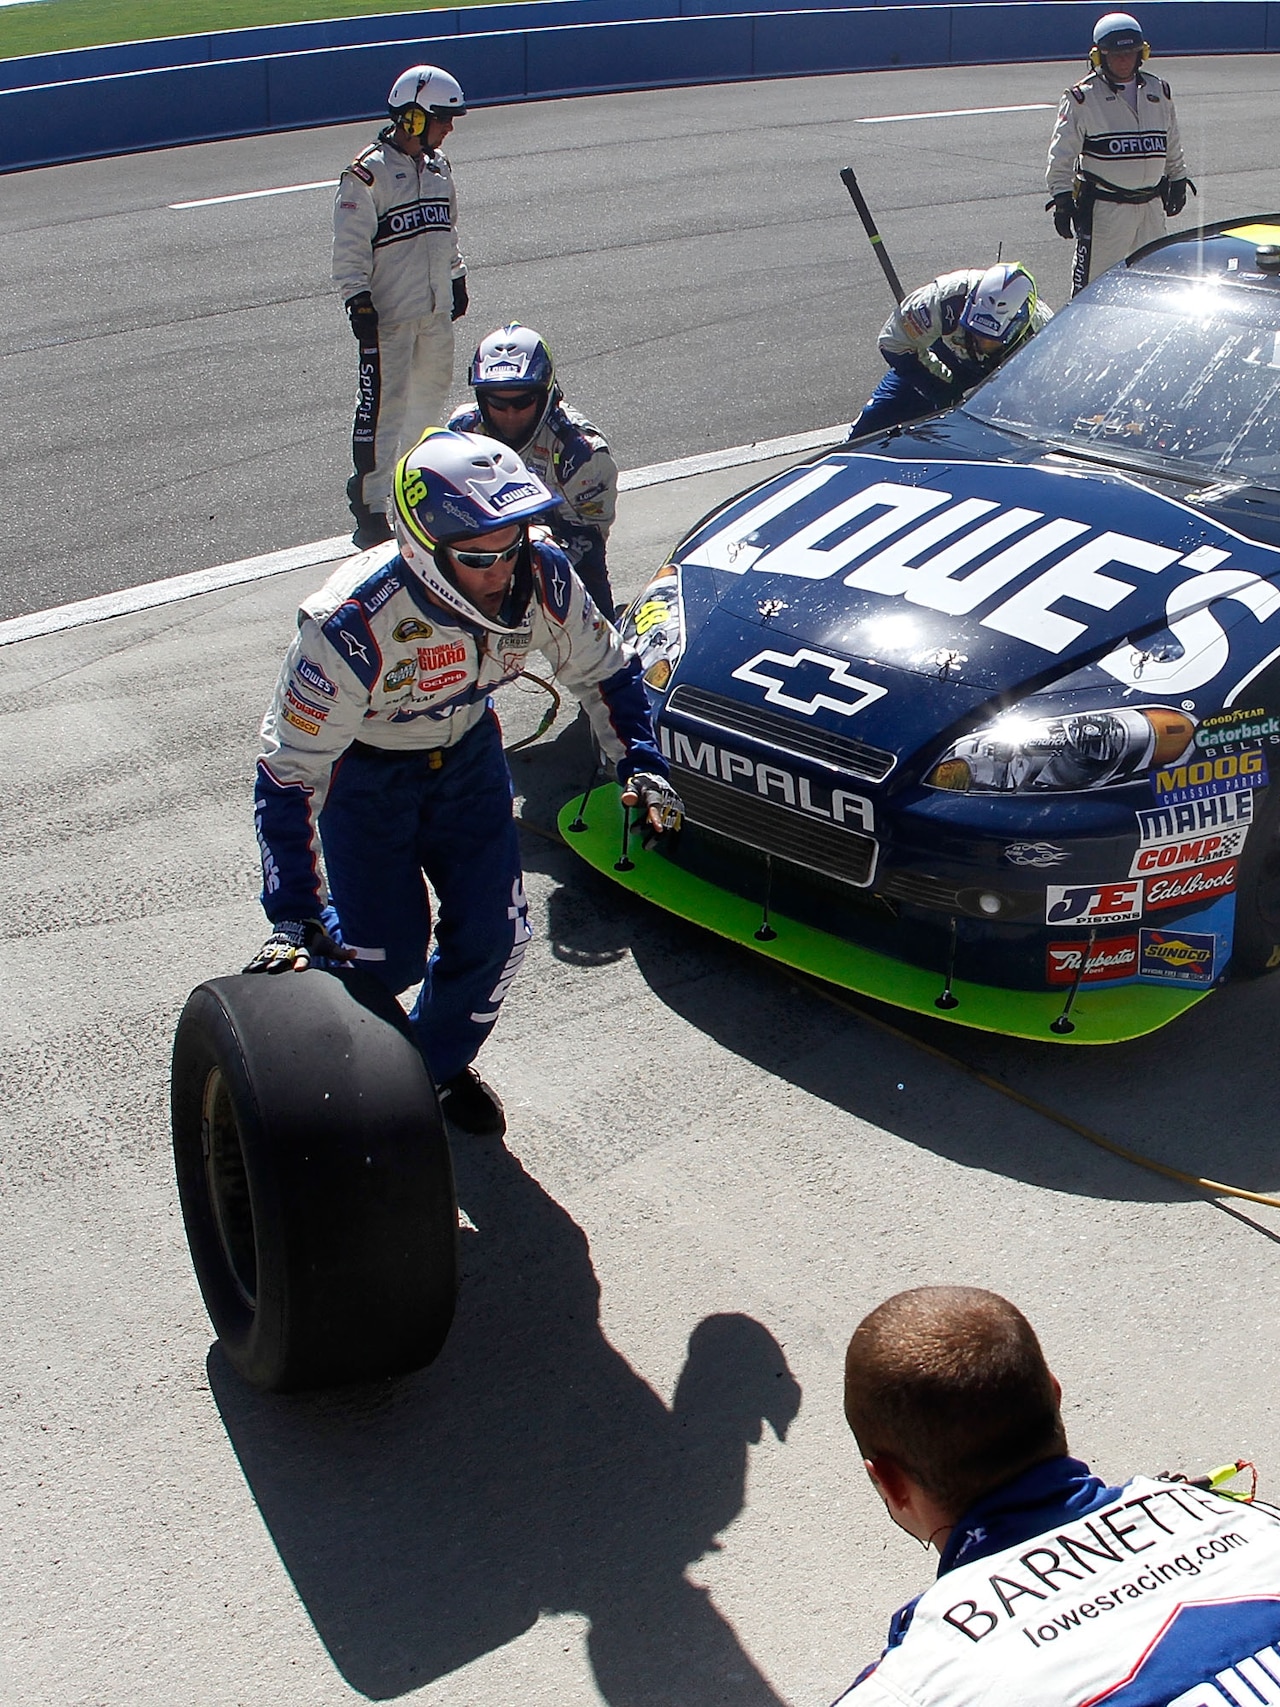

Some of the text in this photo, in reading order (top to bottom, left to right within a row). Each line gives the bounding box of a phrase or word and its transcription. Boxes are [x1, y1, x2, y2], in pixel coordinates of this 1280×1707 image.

[1109, 136, 1166, 154] OFFICIAL
[390, 206, 450, 233] OFFICIAL
[974, 315, 999, 330] LOWE'S
[360, 363, 374, 421] Sprint
[403, 469, 428, 508] 48
[494, 485, 540, 508] LOWE'S
[364, 577, 400, 613] LOWE'S
[634, 601, 671, 636] 48
[299, 661, 332, 693] LOWE'S
[419, 651, 466, 672] GUARD
[422, 673, 463, 688] DELPHI
[289, 711, 317, 735] BOSCH
[1195, 717, 1280, 748] Gatorback
[1206, 735, 1280, 758] BELTS
[661, 724, 875, 833] IMPALA
[1156, 750, 1263, 794] MOOG
[1164, 773, 1263, 806] CHASSIS PARTS
[1137, 792, 1252, 842] MAHLE
[1137, 836, 1222, 872] COMP
[1147, 865, 1235, 904] Edelbrock
[1047, 882, 1139, 924] JE
[1075, 911, 1141, 924] PISTONS
[1147, 945, 1208, 961] SUNOCO
[943, 1487, 1236, 1643] BARNETTE
[1021, 1528, 1249, 1649] lowesracing.com
